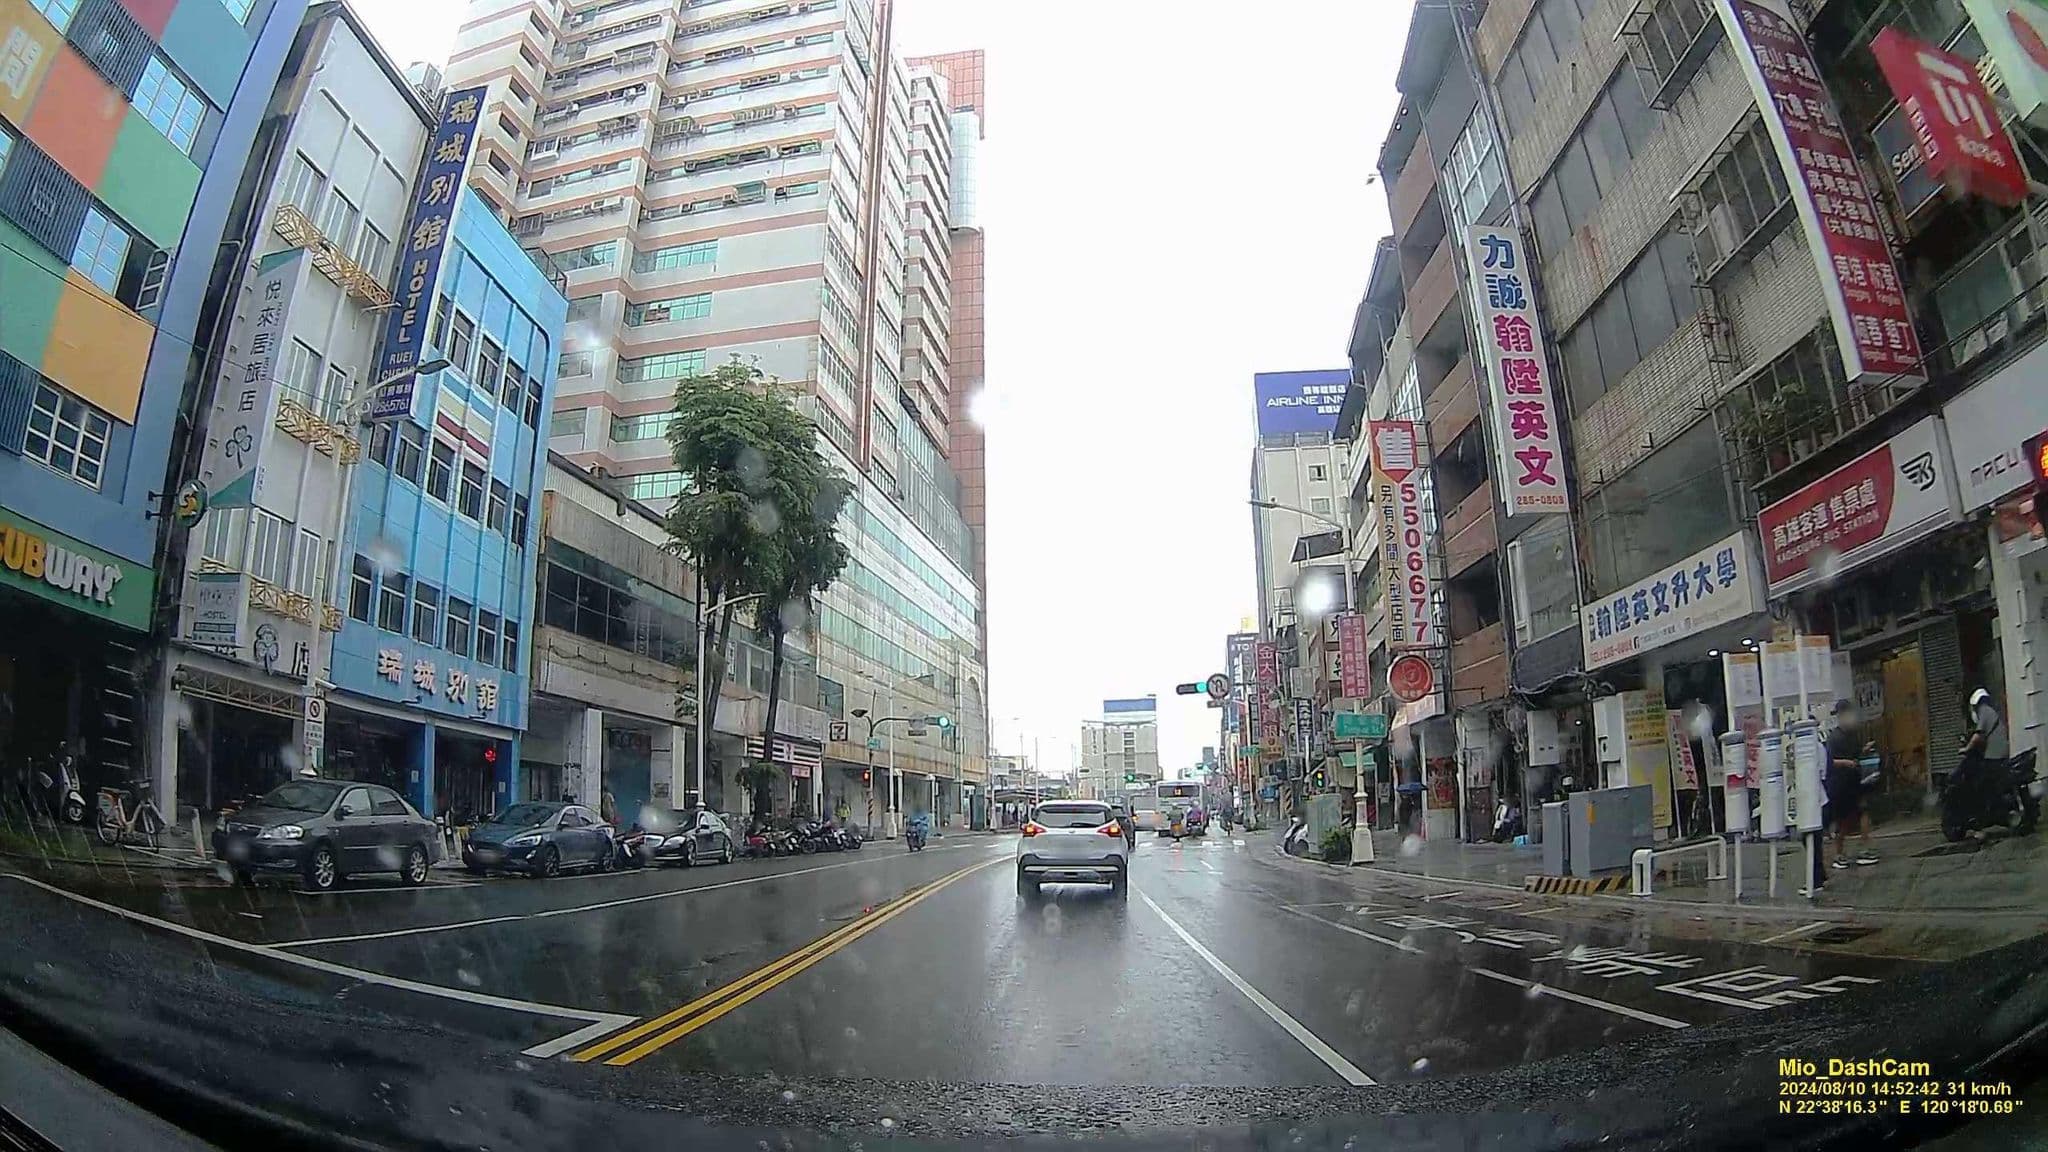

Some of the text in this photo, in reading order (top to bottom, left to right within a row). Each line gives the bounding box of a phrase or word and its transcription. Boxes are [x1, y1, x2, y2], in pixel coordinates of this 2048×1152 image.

[398, 259, 428, 344] HOTEL
[1266, 395, 1319, 408] AIRLINE
[1479, 234, 1557, 487] 力誠翰陞英文
[1375, 427, 1415, 471] 售
[0, 524, 123, 605] UBWAY
[1379, 485, 1404, 642] 另有多間大型店面
[1400, 483, 1428, 643] 5506677
[1772, 501, 1829, 550] 高雄客運
